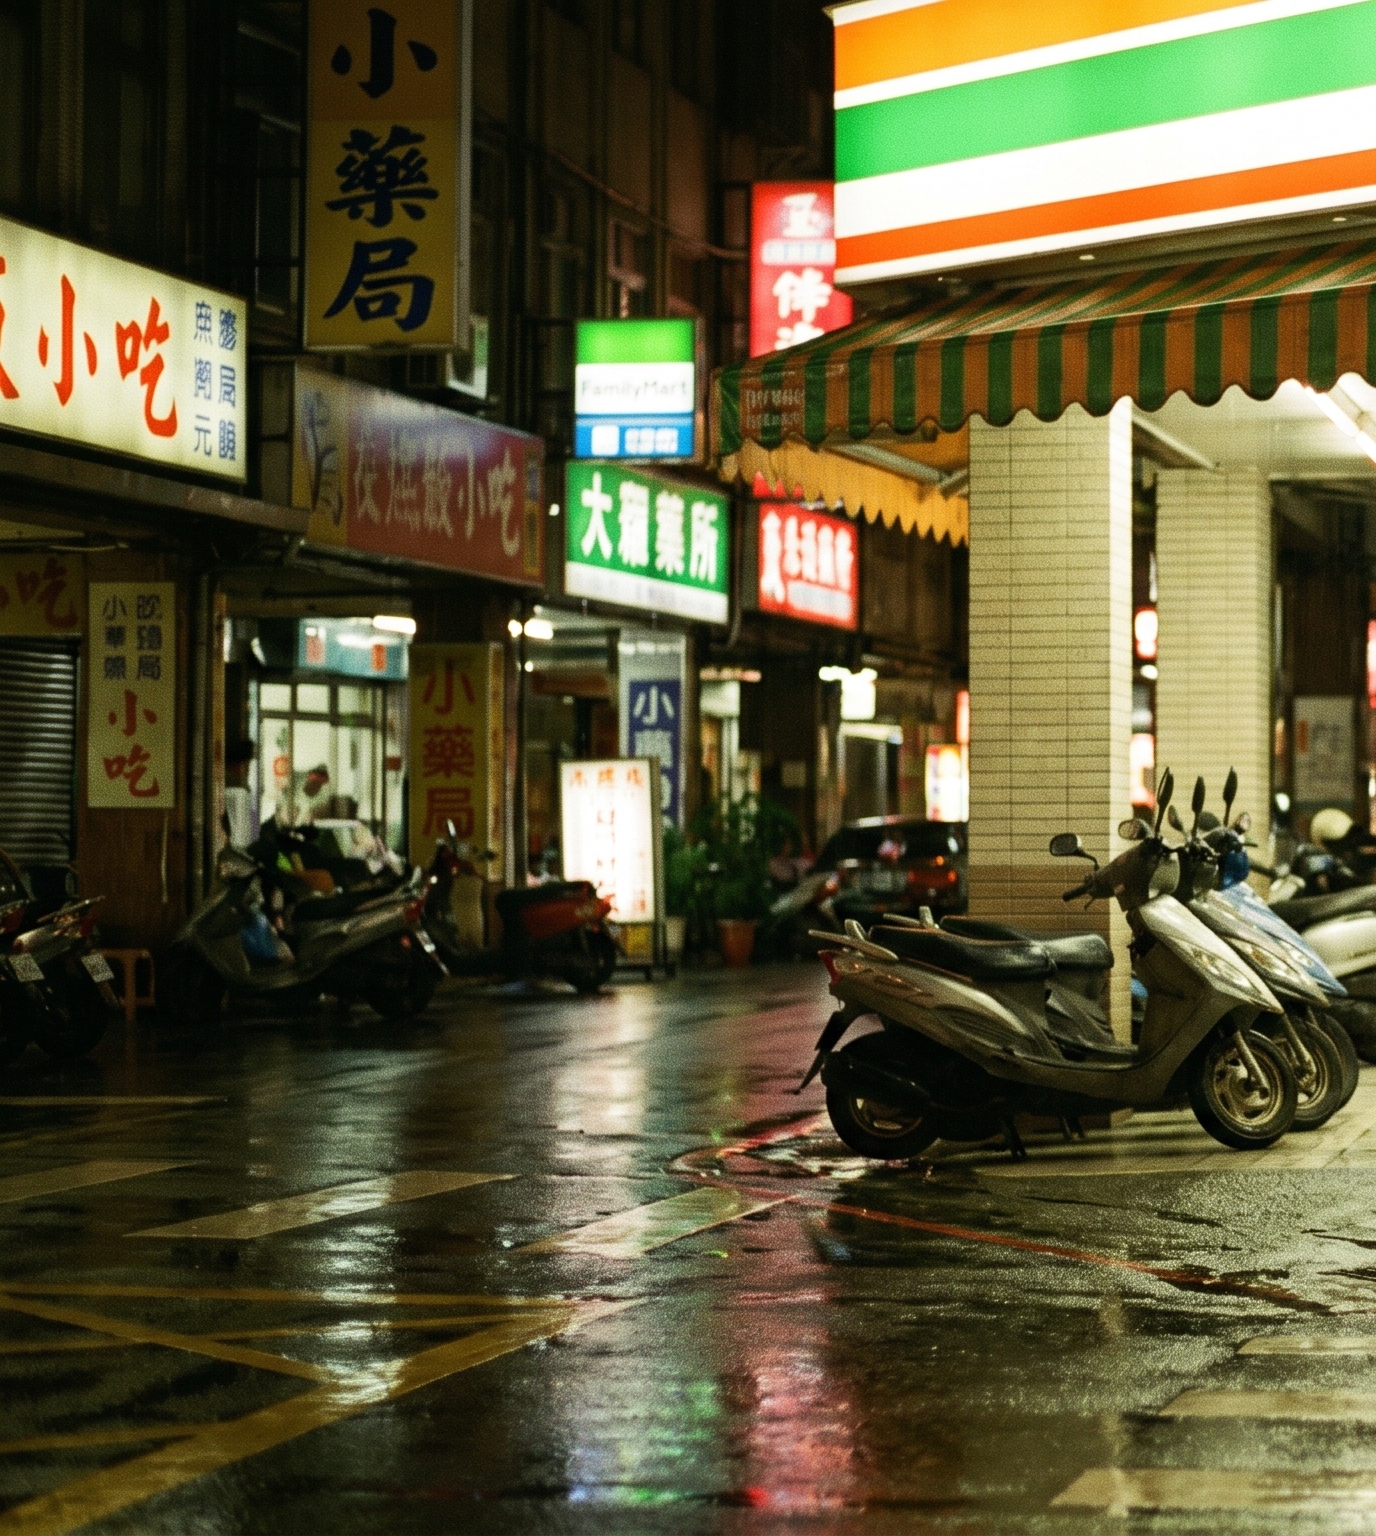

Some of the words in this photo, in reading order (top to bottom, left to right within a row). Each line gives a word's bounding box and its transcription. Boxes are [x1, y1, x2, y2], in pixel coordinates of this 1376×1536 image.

[322, 8, 440, 332] 小藥局
[0, 254, 178, 438] 小吃
[581, 381, 687, 402] FamilyMart
[0, 557, 79, 629] 吃
[103, 688, 160, 797] 小吃
[422, 658, 476, 840] 小藥局
